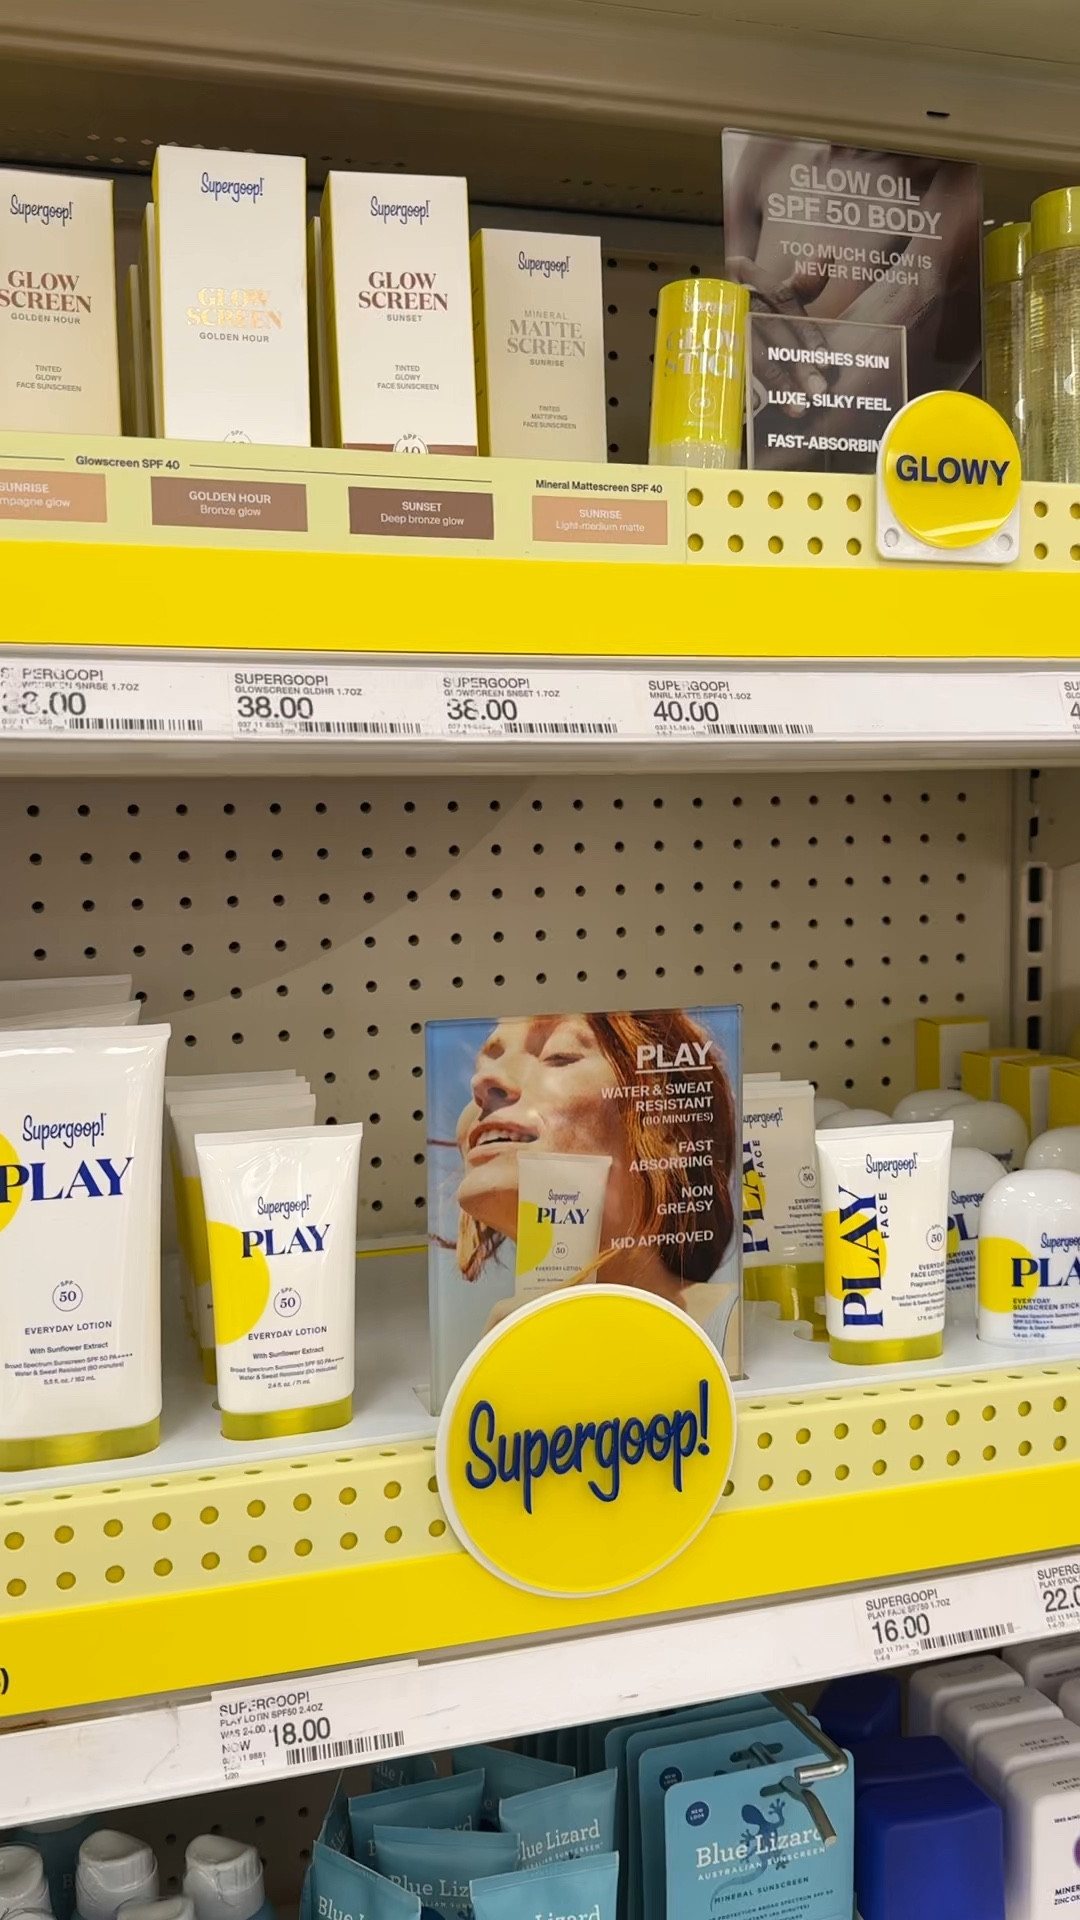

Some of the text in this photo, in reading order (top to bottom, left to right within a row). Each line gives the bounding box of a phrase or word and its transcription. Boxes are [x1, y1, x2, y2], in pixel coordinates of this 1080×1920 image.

[201, 172, 265, 203] Supergoop!
[790, 164, 920, 202] GLOW OIL
[10, 194, 73, 227] Supergoop!
[370, 196, 430, 225] Supergoop!
[767, 193, 942, 235] SPF 50 BODY
[780, 240, 932, 269] TOO MUCH GLOW IS
[518, 251, 570, 279] Supergoop!
[794, 260, 919, 286] NEVER ENOUGH
[8, 270, 79, 292] GLOW
[369, 271, 437, 289] GLOW
[0, 289, 92, 313] SCREEN
[197, 287, 271, 308] GLOW
[358, 291, 448, 311] SCREEN
[11, 312, 81, 325] GOLDEN HOUR
[186, 308, 283, 330] SCREEN
[387, 314, 423, 322] SUNSET
[524, 310, 568, 320] MINERAL
[199, 332, 270, 343] GOLDEN HOUR
[510, 319, 583, 340] MATTE
[506, 338, 586, 357] SCREEN
[529, 358, 565, 367] SUNRISE
[768, 347, 889, 369] NOURISHES SKIN
[35, 365, 62, 374] TINTED
[395, 364, 420, 372] TINTED
[35, 374, 62, 382] GLOWY
[395, 373, 421, 381] GLOWY
[16, 382, 82, 392] FACE SUNSCREEN
[377, 382, 439, 391] FACE SUNSCREEN
[768, 390, 892, 412] LUXE, SILKY FEEL
[531, 413, 568, 421] MATTIFYING
[539, 422, 577, 430] SUNSCREEN
[75, 455, 180, 470] Glowscreen SPF 40
[896, 454, 1010, 486] GLOWY
[536, 480, 663, 494] Mineral Mattescreen SPF 40
[45, 497, 71, 509] glow
[188, 490, 272, 504] GOLDEN HOUR
[200, 504, 261, 518] Bronze glow
[401, 501, 442, 513] SUNSET
[579, 508, 622, 520] SUNRISE
[380, 513, 464, 527] Deep bronze glow
[619, 522, 645, 532] matte
[234, 673, 329, 686] SUPERGOOP!
[235, 686, 300, 694] GLOWSCREEN
[303, 687, 335, 695] GLDHR
[506, 690, 534, 698] SNSET
[237, 695, 314, 719] 38.00
[446, 698, 518, 721] 38.00
[653, 700, 720, 722] 40.00
[636, 1041, 713, 1069] PLAY
[601, 1081, 713, 1099] WATER & SWEAT
[636, 1096, 713, 1112] RESISTANT
[662, 1112, 714, 1125] MINUTES)
[22, 1112, 105, 1150] Supergoop!
[678, 1140, 713, 1153] FAST
[629, 1156, 713, 1172] ABSORBING
[752, 1140, 766, 1178] FACE
[865, 1152, 919, 1179] Supergoop!
[0, 1157, 134, 1204] PLAY
[681, 1185, 713, 1198] NON
[257, 1194, 312, 1220] Supergoop!
[657, 1200, 714, 1215] GREASY
[537, 1207, 590, 1225] PLAY
[879, 1192, 890, 1239] FACE
[241, 1224, 330, 1258] PLAY
[611, 1230, 714, 1249] KID APPROVED
[931, 1233, 942, 1243] 50
[838, 1184, 884, 1328] PLAY
[910, 1271, 926, 1279] FACE
[59, 1290, 77, 1303] 50
[280, 1297, 296, 1309] 50
[1060, 1302, 1080, 1310] STICK
[25, 1321, 112, 1336] EVERYDAY LOTION
[248, 1326, 327, 1341] EVERYDAY LOTION
[29, 1342, 109, 1355] With Sunflower Extract
[302, 1346, 324, 1355] Extract
[465, 1379, 711, 1515] Supergoop!
[1039, 1579, 1056, 1589] PLAY
[865, 1588, 939, 1612] SUPERGOOP!
[867, 1611, 886, 1621] PLAY
[872, 1613, 930, 1644] 16.00
[271, 1708, 297, 1719] SPF50
[299, 1703, 323, 1714] 2.4OZ
[269, 1717, 331, 1747] 18.00
[545, 1818, 600, 1850] Lizard
[695, 1841, 749, 1868] Blue
[697, 1847, 826, 1881] AUSTRALIAN SUNSCREEN
[714, 1877, 810, 1904] MINERAL SUNSCREEN
[1054, 1896, 1070, 1905] ZINC
